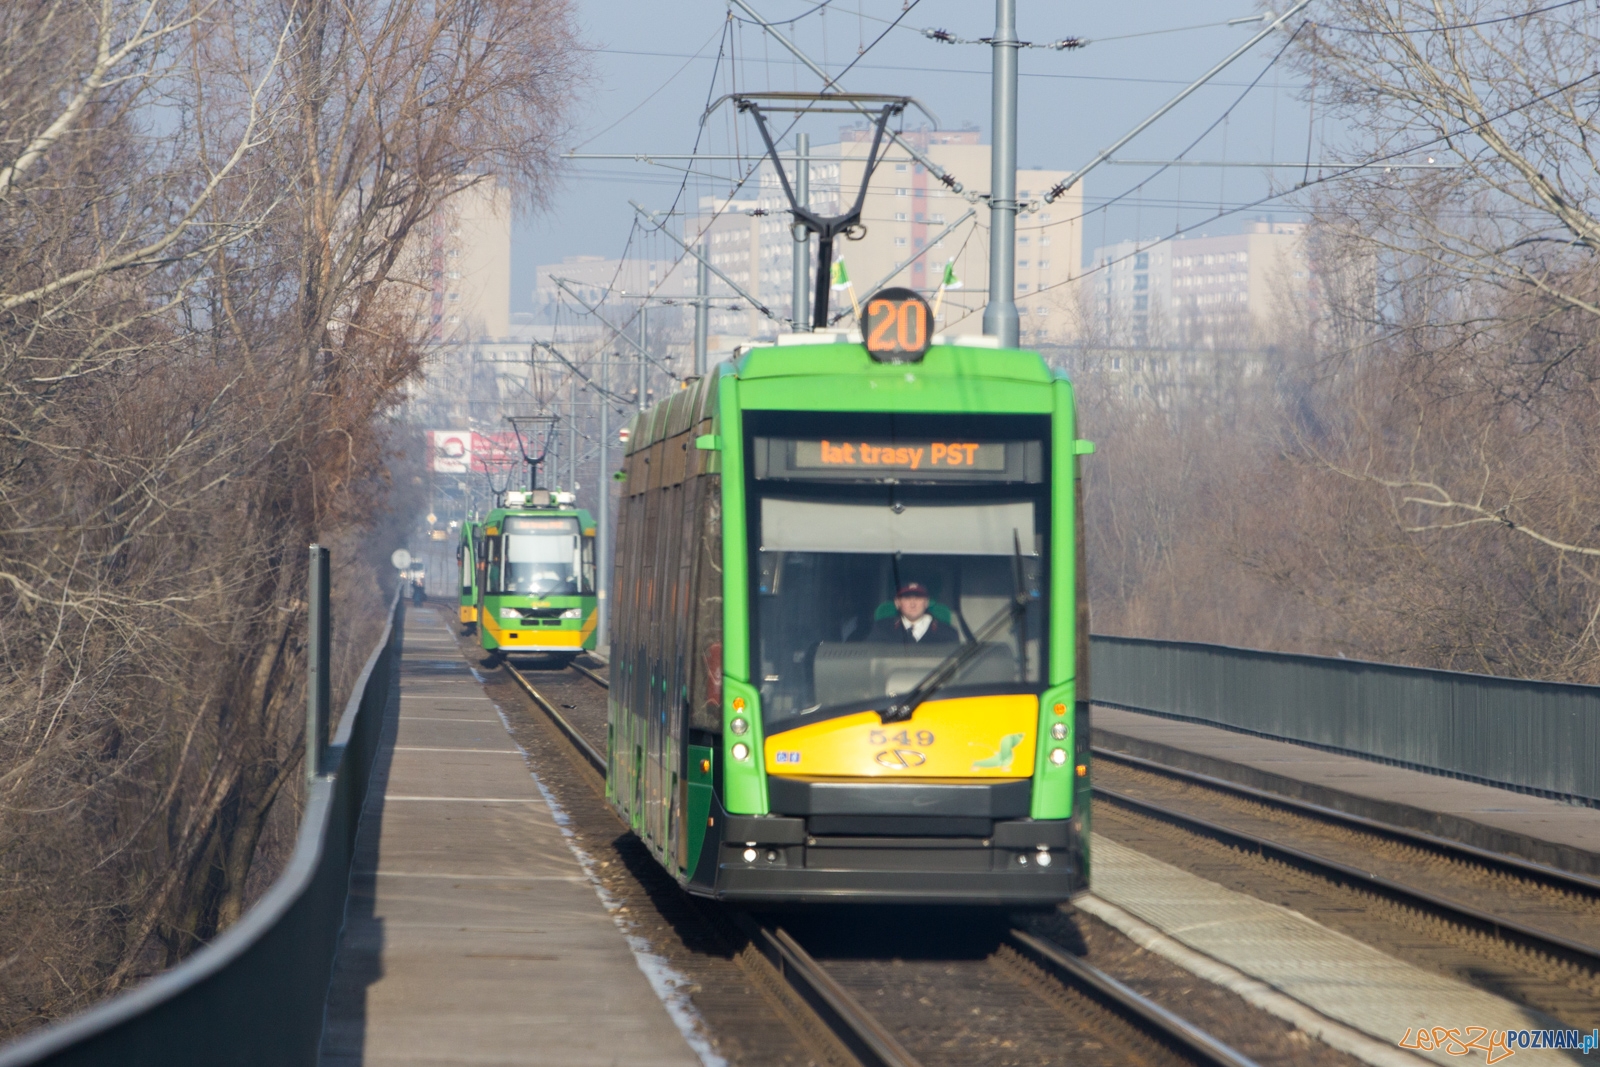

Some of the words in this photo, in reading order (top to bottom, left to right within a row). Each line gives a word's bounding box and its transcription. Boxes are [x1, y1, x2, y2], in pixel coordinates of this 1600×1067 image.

[867, 298, 927, 352] 20
[820, 440, 856, 464] lat
[859, 442, 924, 470] trasy
[931, 442, 979, 465] PST
[869, 729, 935, 747] 549
